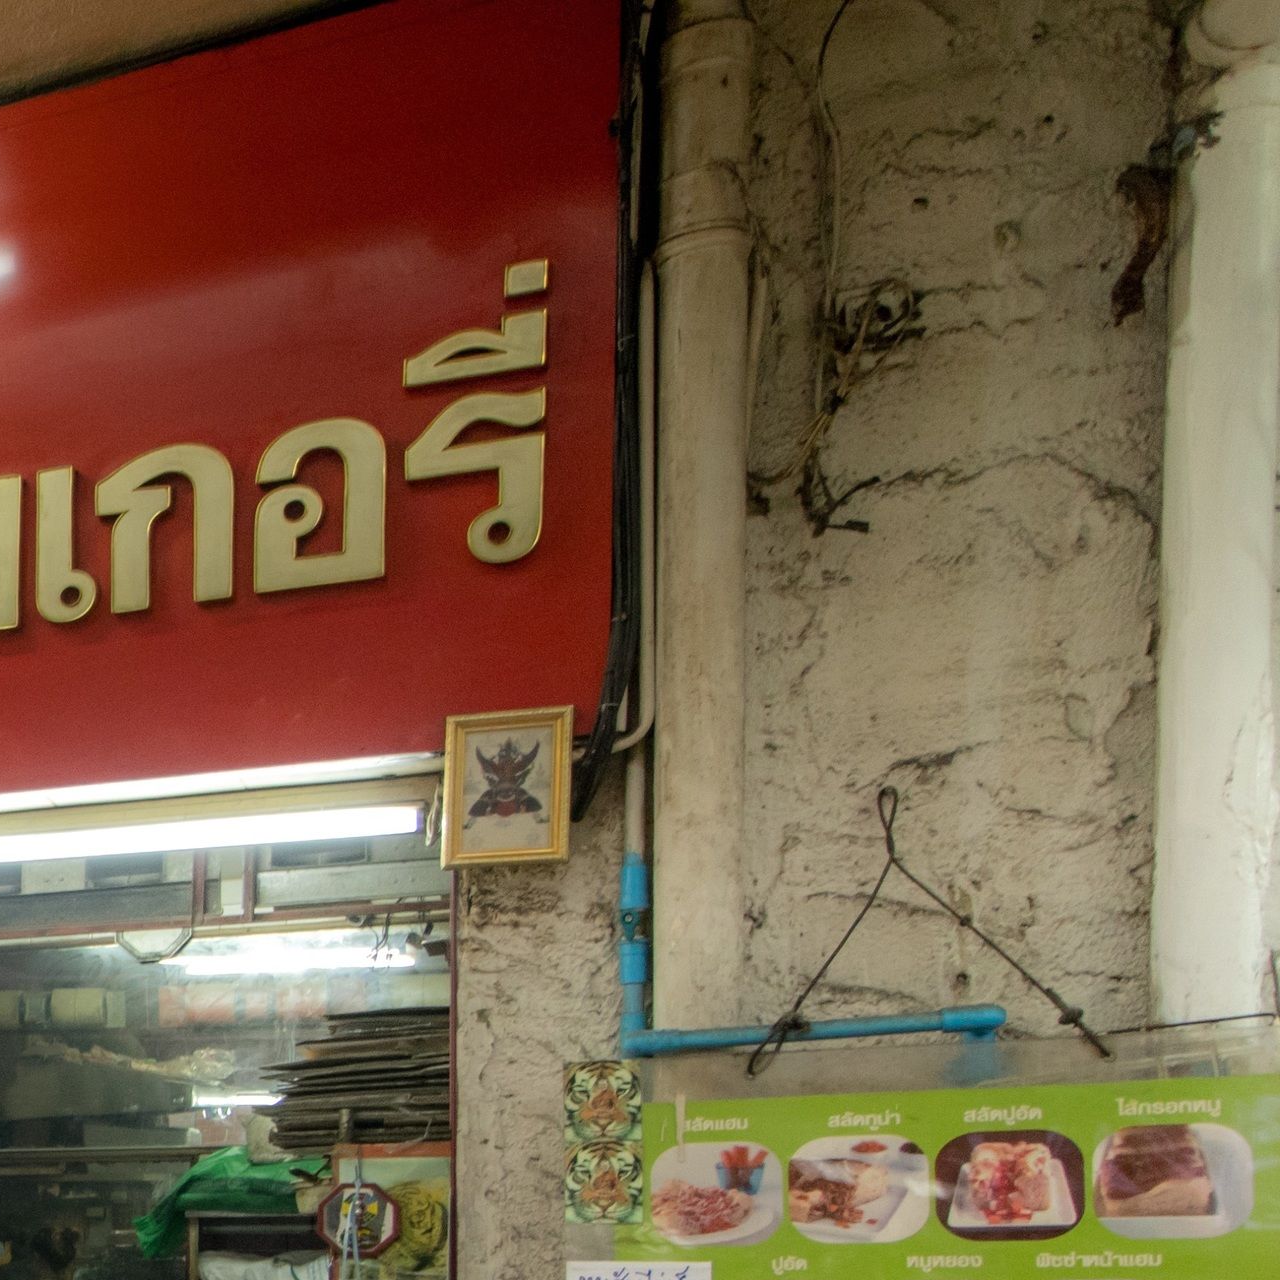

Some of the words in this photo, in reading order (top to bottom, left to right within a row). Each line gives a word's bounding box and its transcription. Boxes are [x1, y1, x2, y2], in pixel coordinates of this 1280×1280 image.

[828, 1104, 901, 1131] สลัดทูน่า
[964, 1105, 1042, 1125] สลัดปูอัด
[772, 1257, 808, 1275] ปูอัด
[906, 1254, 983, 1272] หมูหยอง
